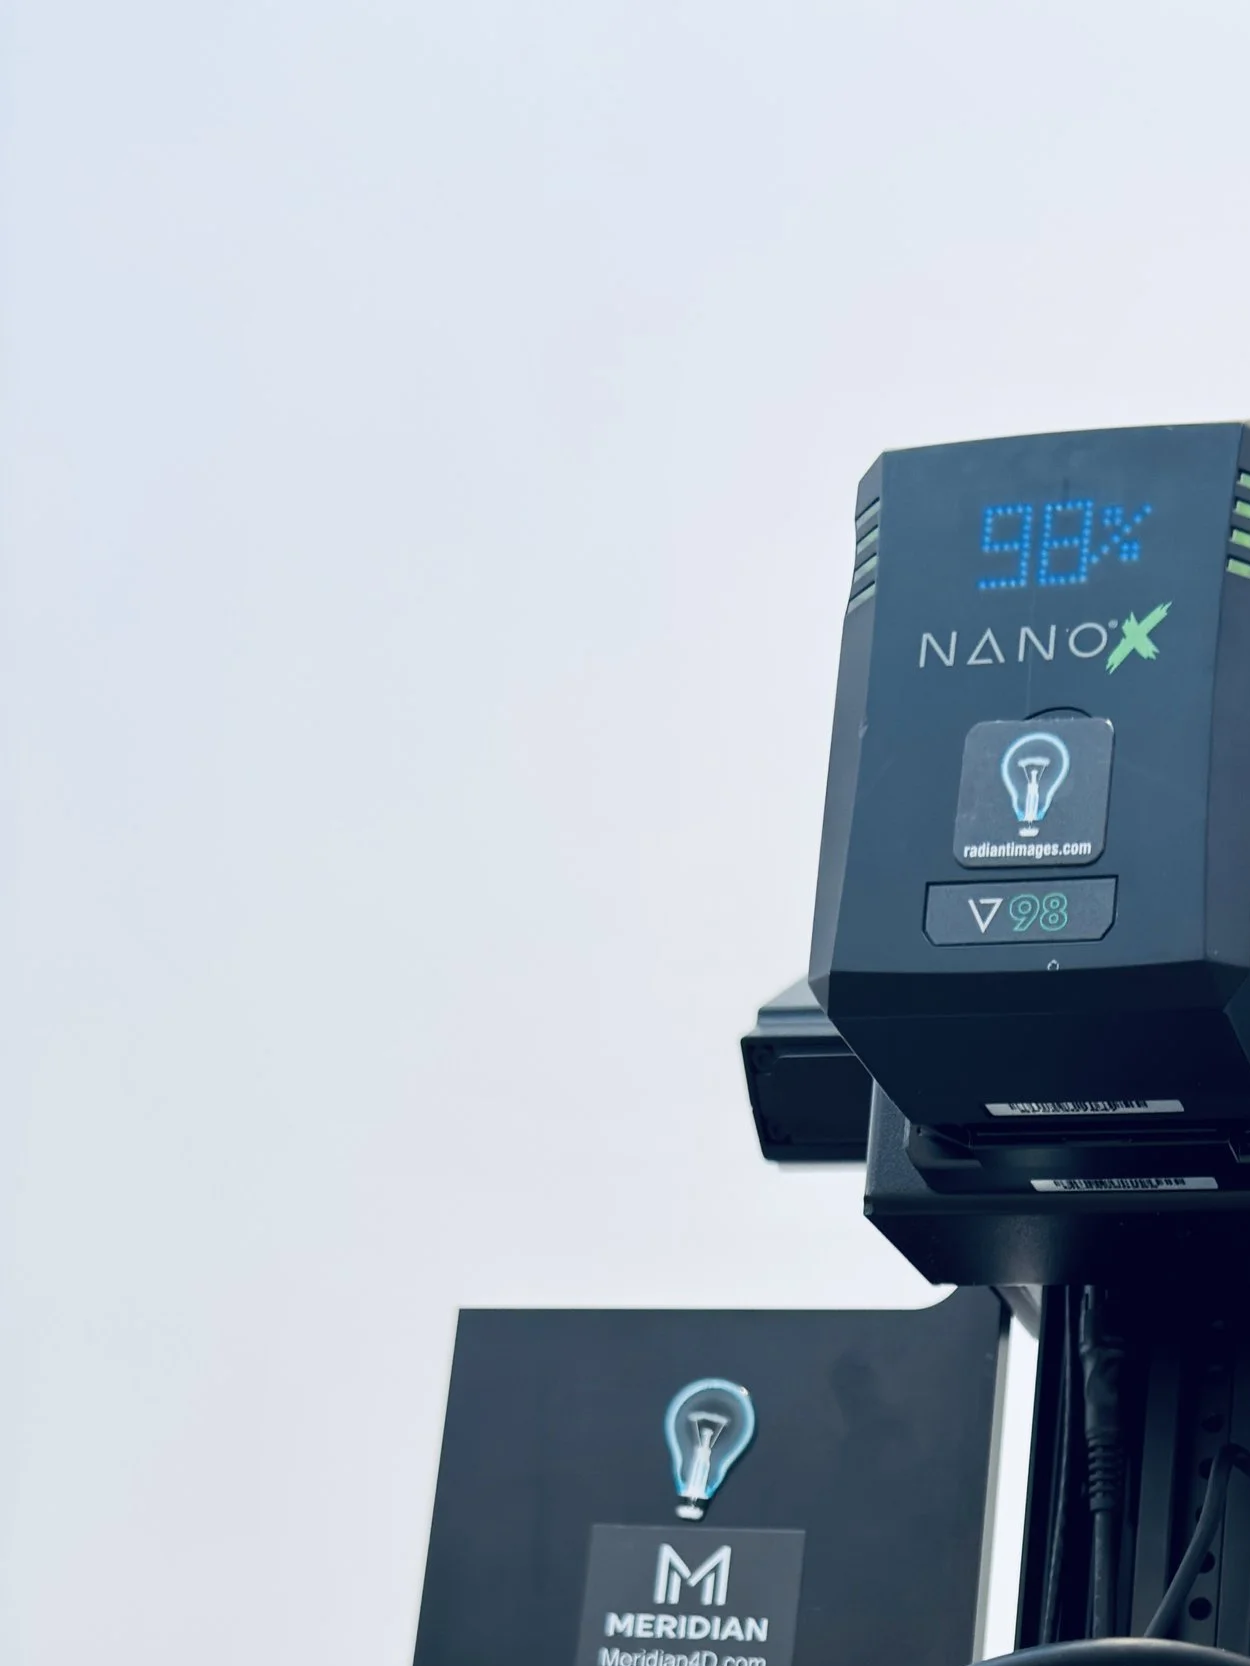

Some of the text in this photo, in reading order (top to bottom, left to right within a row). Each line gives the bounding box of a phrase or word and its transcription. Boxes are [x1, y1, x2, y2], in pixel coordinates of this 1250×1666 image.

[977, 499, 1153, 591] 98%
[963, 841, 1092, 860] radiantimages.com
[605, 1612, 769, 1643] MERIDIAN
